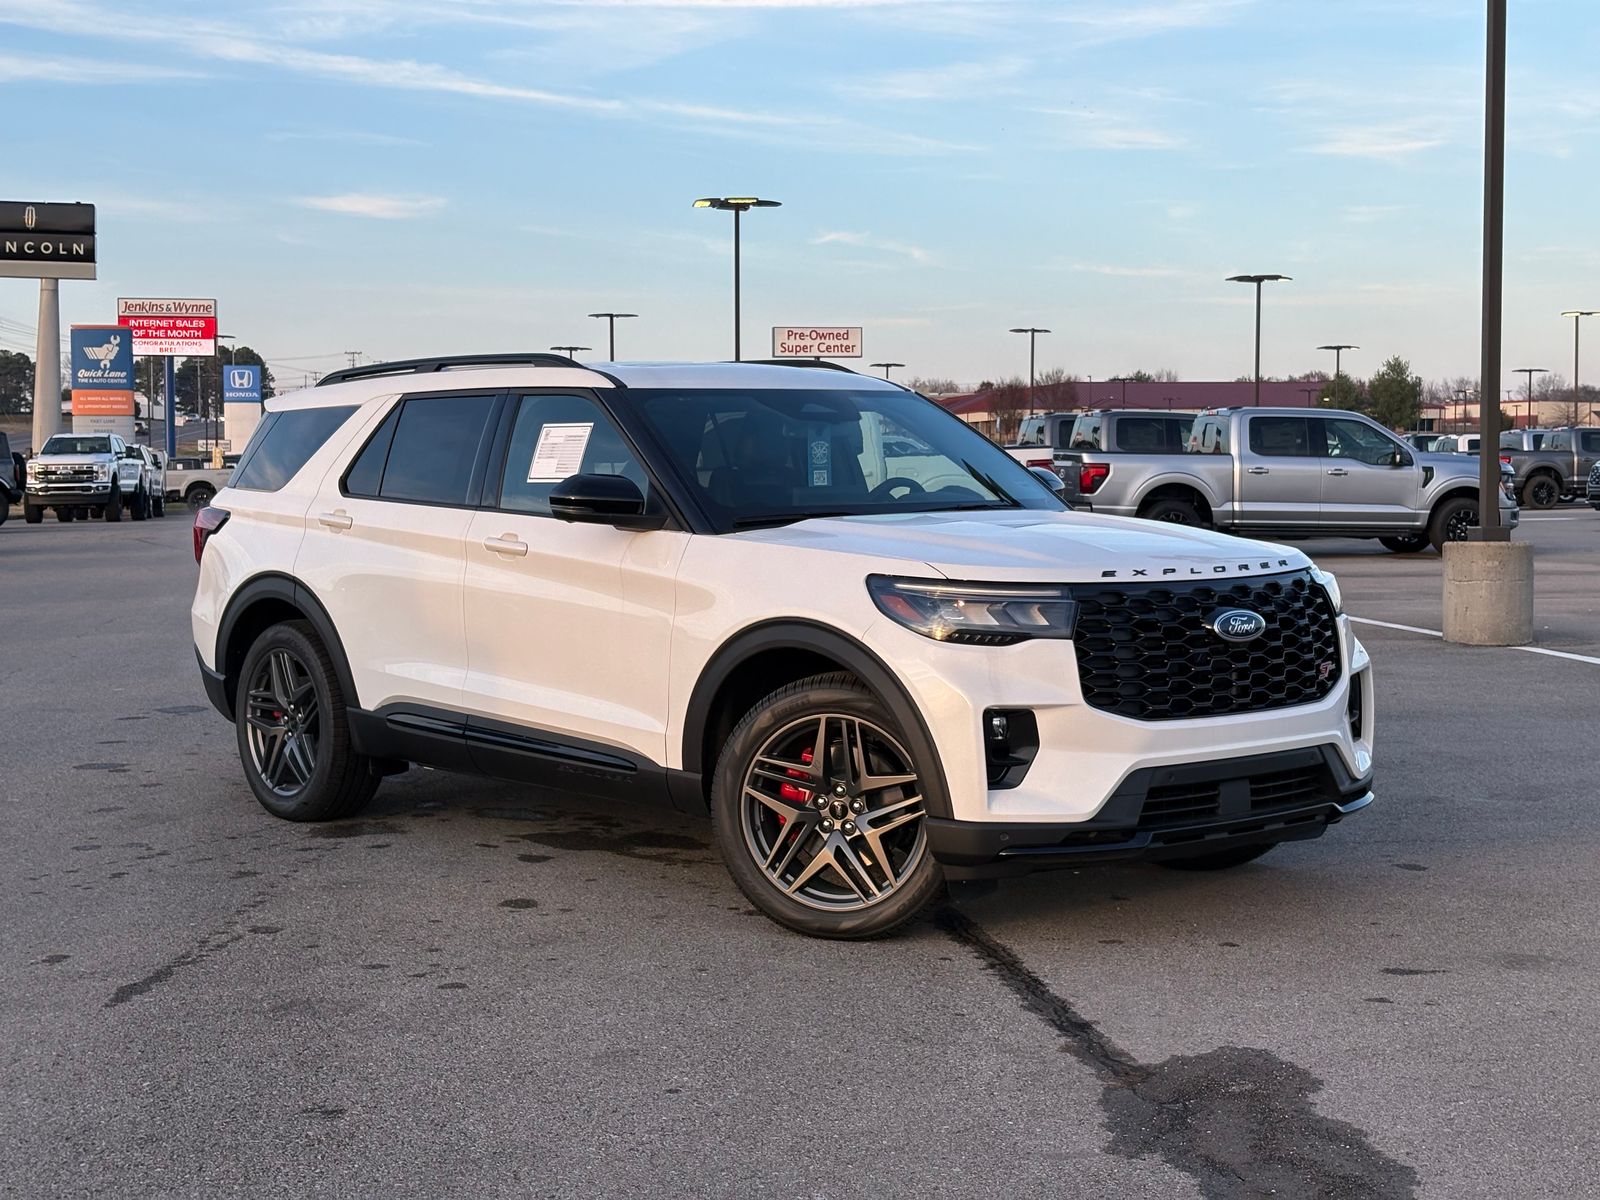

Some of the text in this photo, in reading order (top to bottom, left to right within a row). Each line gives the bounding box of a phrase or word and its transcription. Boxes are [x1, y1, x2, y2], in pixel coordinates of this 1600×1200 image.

[5, 241, 84, 255] NCOLN
[121, 301, 164, 314] Jenkins
[172, 302, 212, 314] Wynne
[129, 319, 206, 328] INTERNET SALES
[132, 329, 202, 338] OF THE MONTH
[787, 329, 849, 340] Pre-Owned
[780, 342, 856, 355] Super Center
[77, 369, 127, 378] Quick Lane
[1101, 559, 1289, 578] EXPLORER
[1228, 616, 1256, 634] Ford
